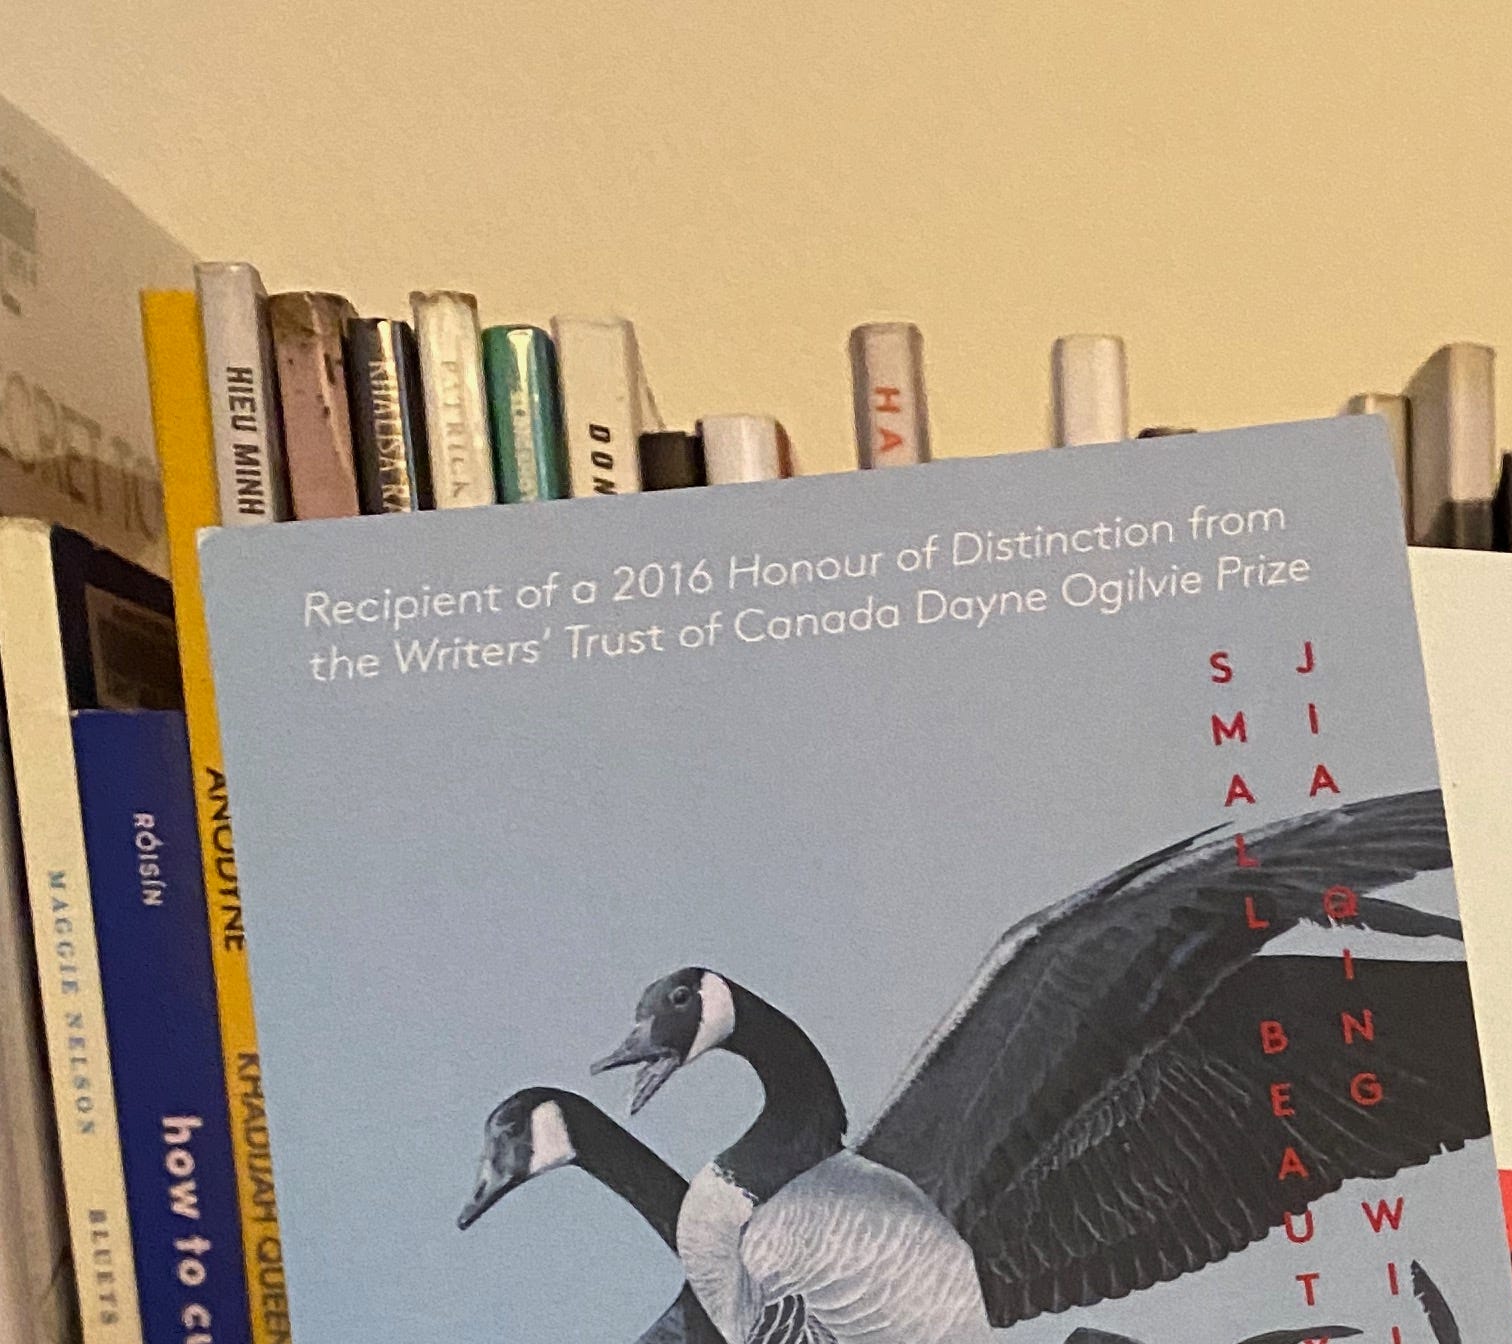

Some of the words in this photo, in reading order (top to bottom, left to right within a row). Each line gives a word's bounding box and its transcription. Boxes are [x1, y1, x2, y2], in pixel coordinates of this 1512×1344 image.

[226, 365, 256, 432] HIEU
[233, 445, 266, 515] MINH
[304, 583, 501, 630] Recipient
[516, 571, 560, 611] of
[572, 579, 596, 604] a
[613, 558, 713, 600] 2016
[729, 551, 884, 590] Honour
[897, 535, 940, 572] of
[952, 517, 1174, 567] Distinction
[1189, 505, 1286, 540] from
[310, 643, 380, 681] the
[565, 624, 664, 660] Trust
[679, 610, 723, 648] of
[735, 595, 900, 643] Canada
[917, 585, 1048, 628] Dayne
[1061, 564, 1202, 615] Ogilvie
[1217, 554, 1311, 591] Prize
[1296, 641, 1341, 798] JIA
[1209, 650, 1270, 930] SMALL
[48, 870, 79, 996] MAGGIE
[64, 1011, 96, 1135] NELSON
[88, 1208, 119, 1327] BLUETS
[160, 1113, 203, 1221] how
[168, 1236, 211, 1287] to
